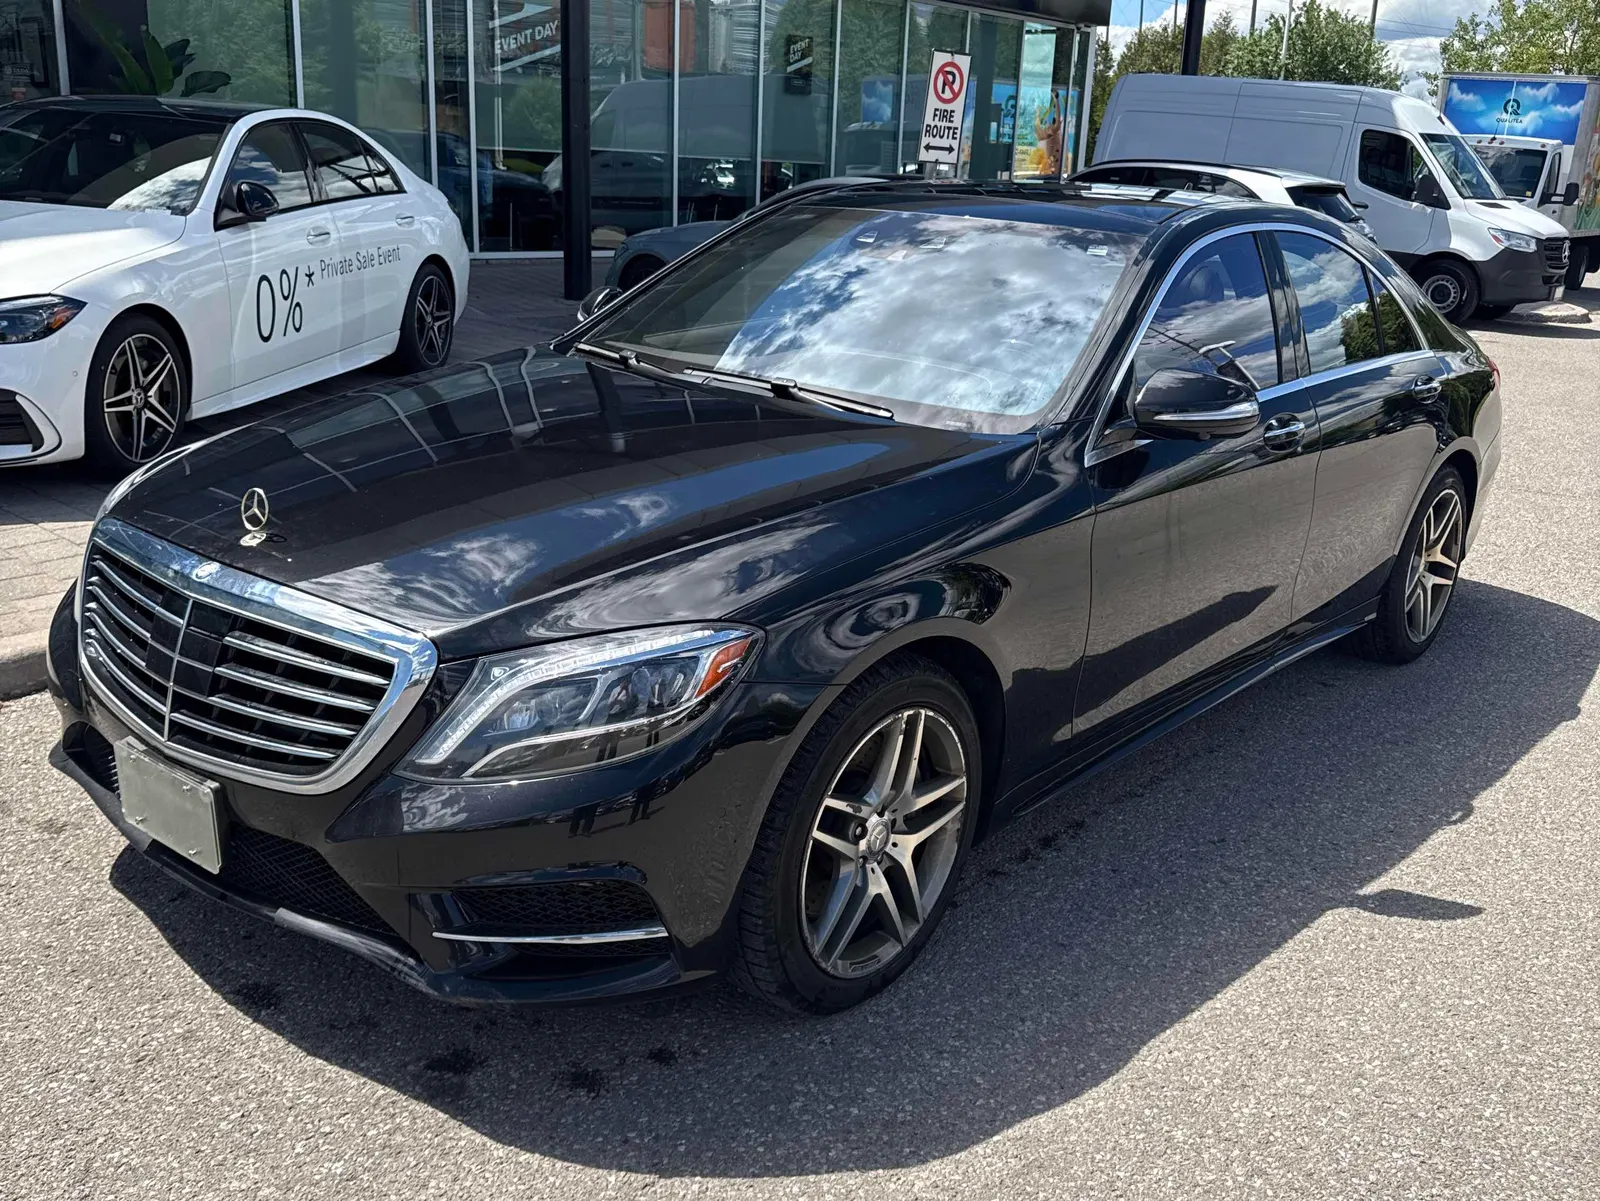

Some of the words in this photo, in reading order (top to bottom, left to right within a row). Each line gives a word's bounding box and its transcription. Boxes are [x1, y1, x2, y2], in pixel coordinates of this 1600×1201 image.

[495, 29, 533, 54] EVENT
[535, 20, 559, 40] DAY
[790, 38, 809, 53] EVENT
[790, 51, 802, 62] DAY
[941, 70, 957, 95] P
[932, 108, 955, 123] FIRE
[924, 124, 959, 140] ROUTE
[320, 256, 353, 279] Private
[356, 250, 375, 271] Sale
[377, 246, 401, 266] Event
